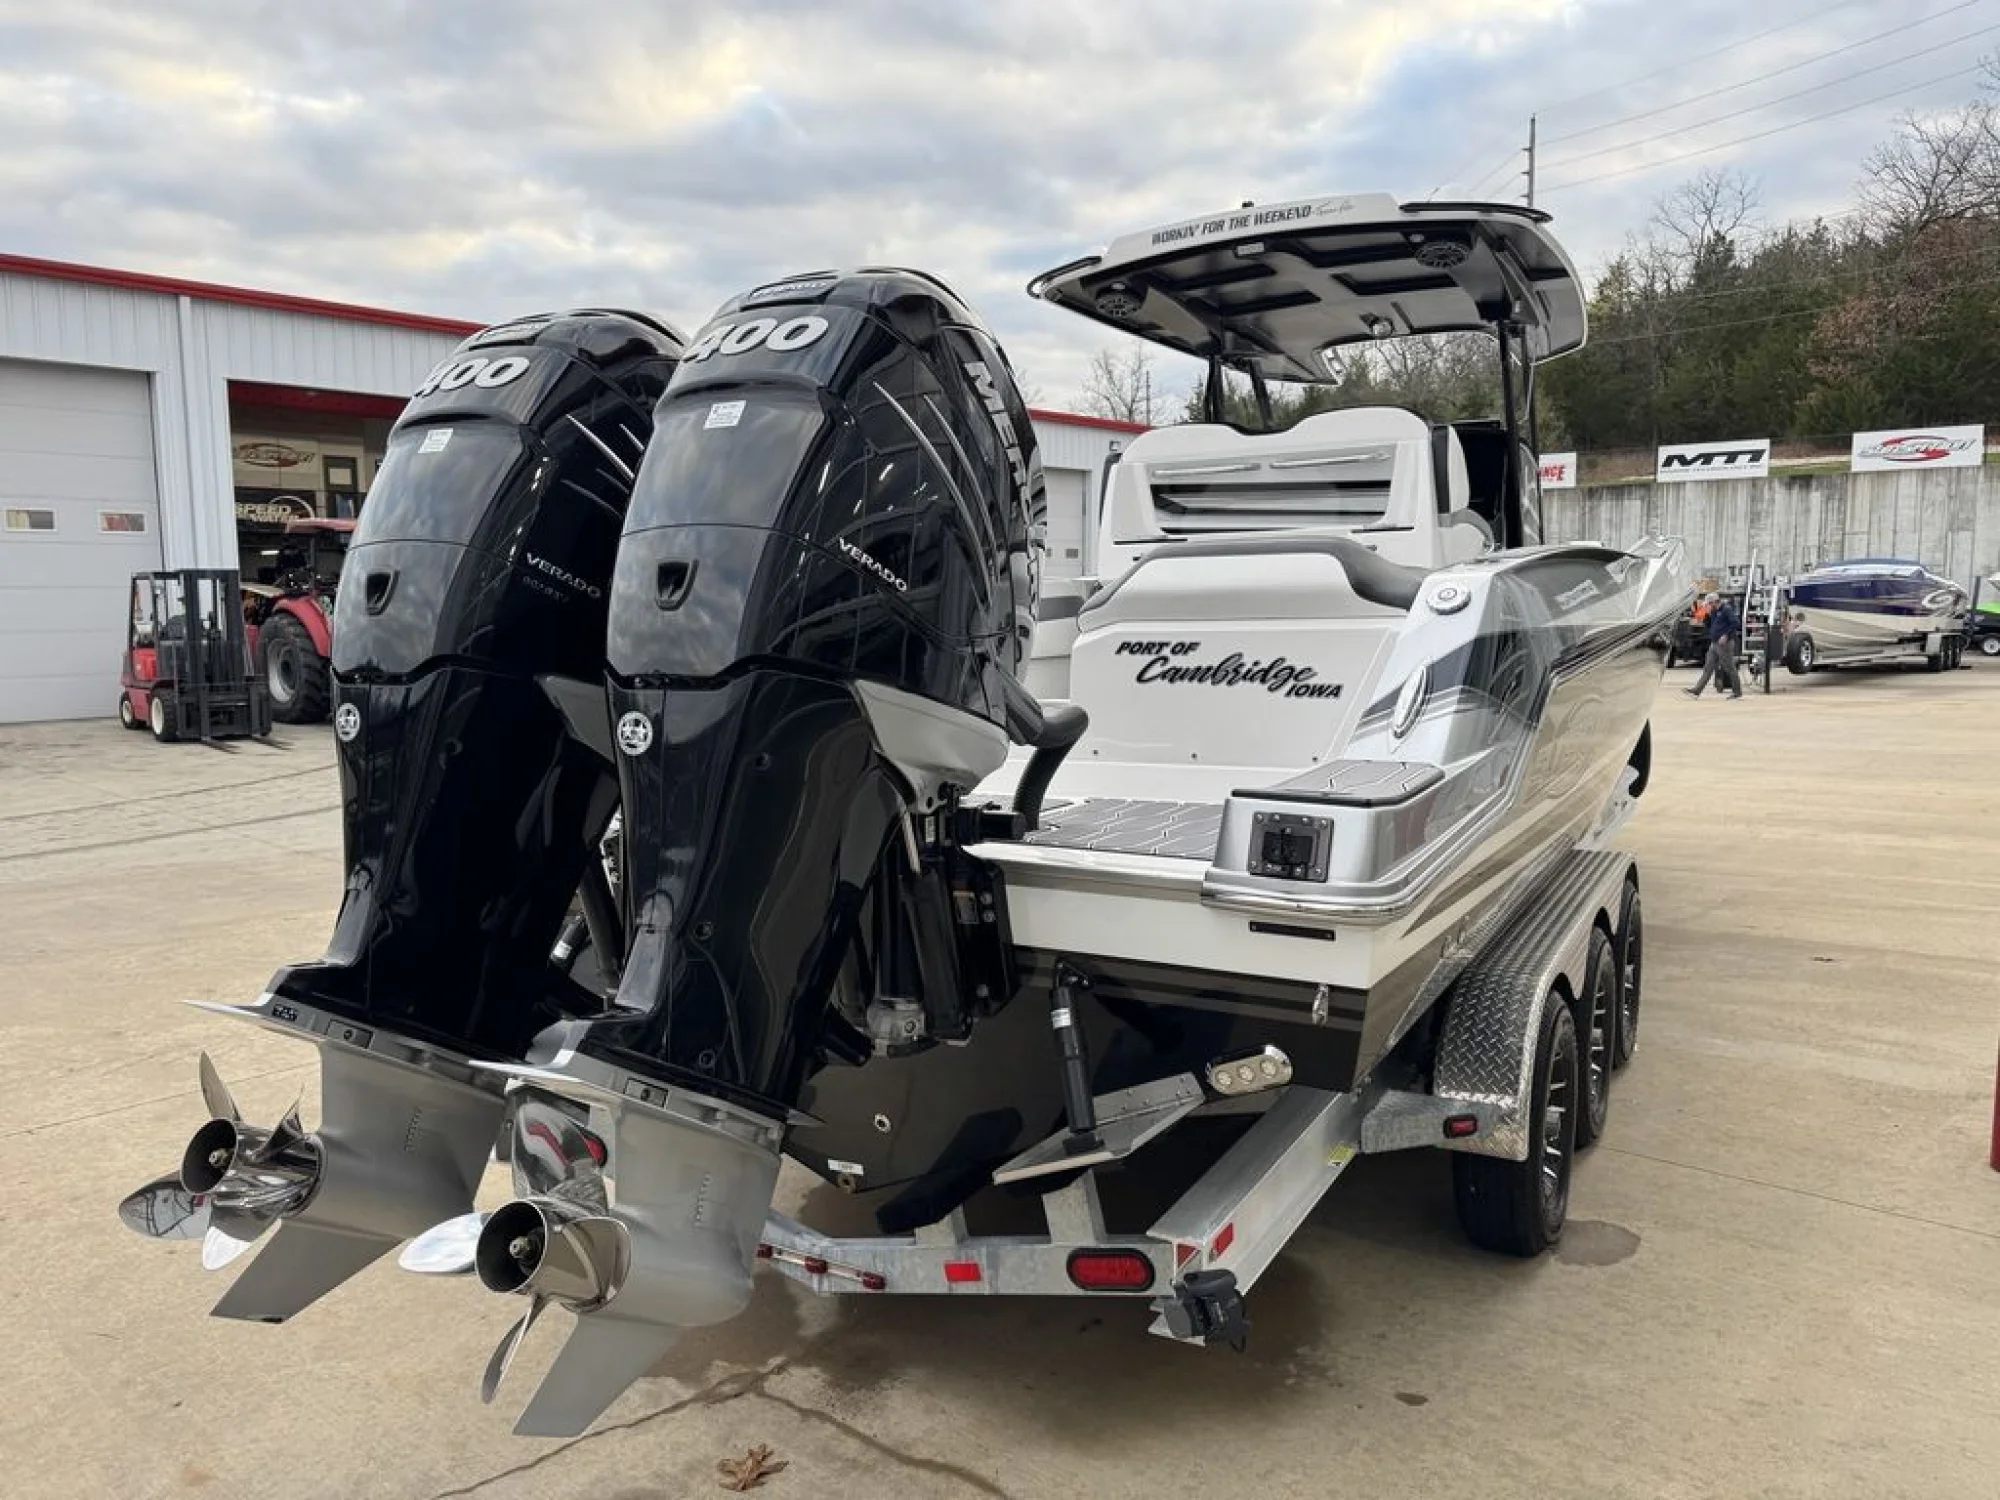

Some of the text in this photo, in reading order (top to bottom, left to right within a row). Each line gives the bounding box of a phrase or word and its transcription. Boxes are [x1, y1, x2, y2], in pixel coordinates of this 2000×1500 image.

[1151, 224, 1200, 245] WORKIN'
[1202, 219, 1225, 235] FOR
[1229, 213, 1250, 231] THE
[1253, 205, 1311, 225] WEEKEND
[681, 315, 828, 363] 400
[1661, 449, 1766, 468] MTI
[526, 552, 601, 598] VERADO
[840, 536, 907, 592] VERADO
[1115, 640, 1201, 656] PORT OF
[1135, 651, 1318, 693] Cambridge
[1284, 683, 1344, 699] IOWA
